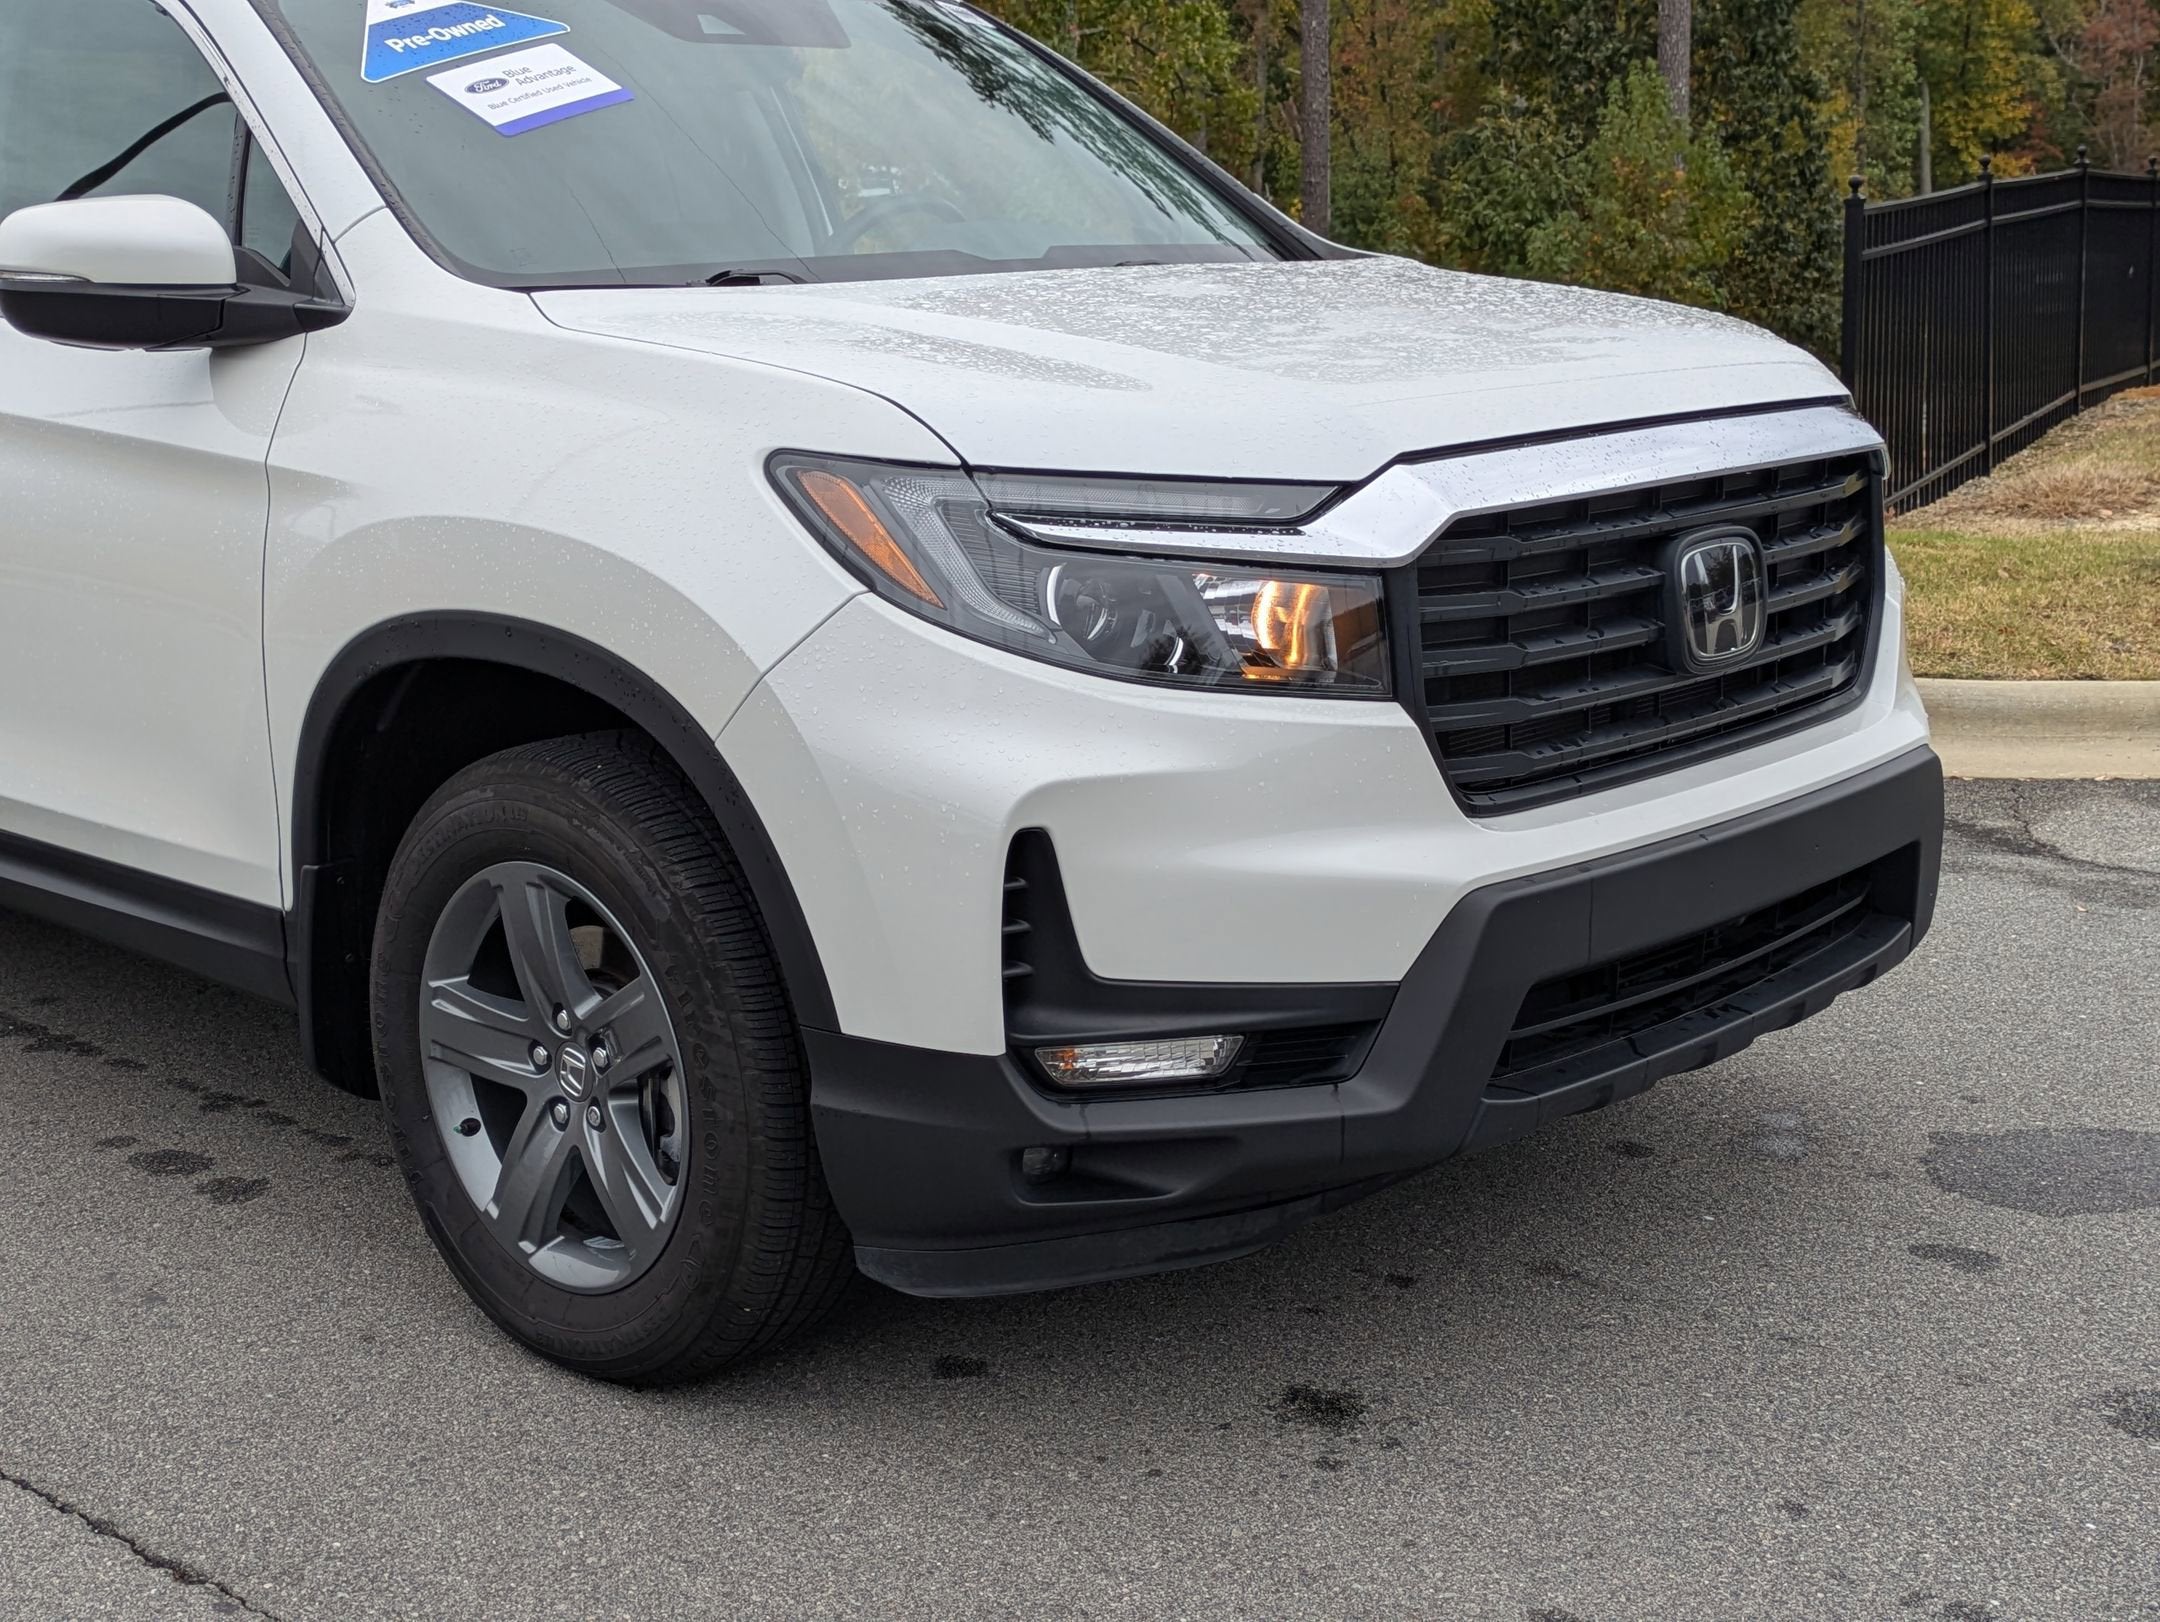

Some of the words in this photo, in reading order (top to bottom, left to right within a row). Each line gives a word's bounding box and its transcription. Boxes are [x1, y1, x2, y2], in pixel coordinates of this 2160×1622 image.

[384, 14, 506, 53] Pre-Owned
[502, 66, 532, 78] Blue
[515, 65, 576, 86] Advantage
[508, 89, 544, 105] Certified
